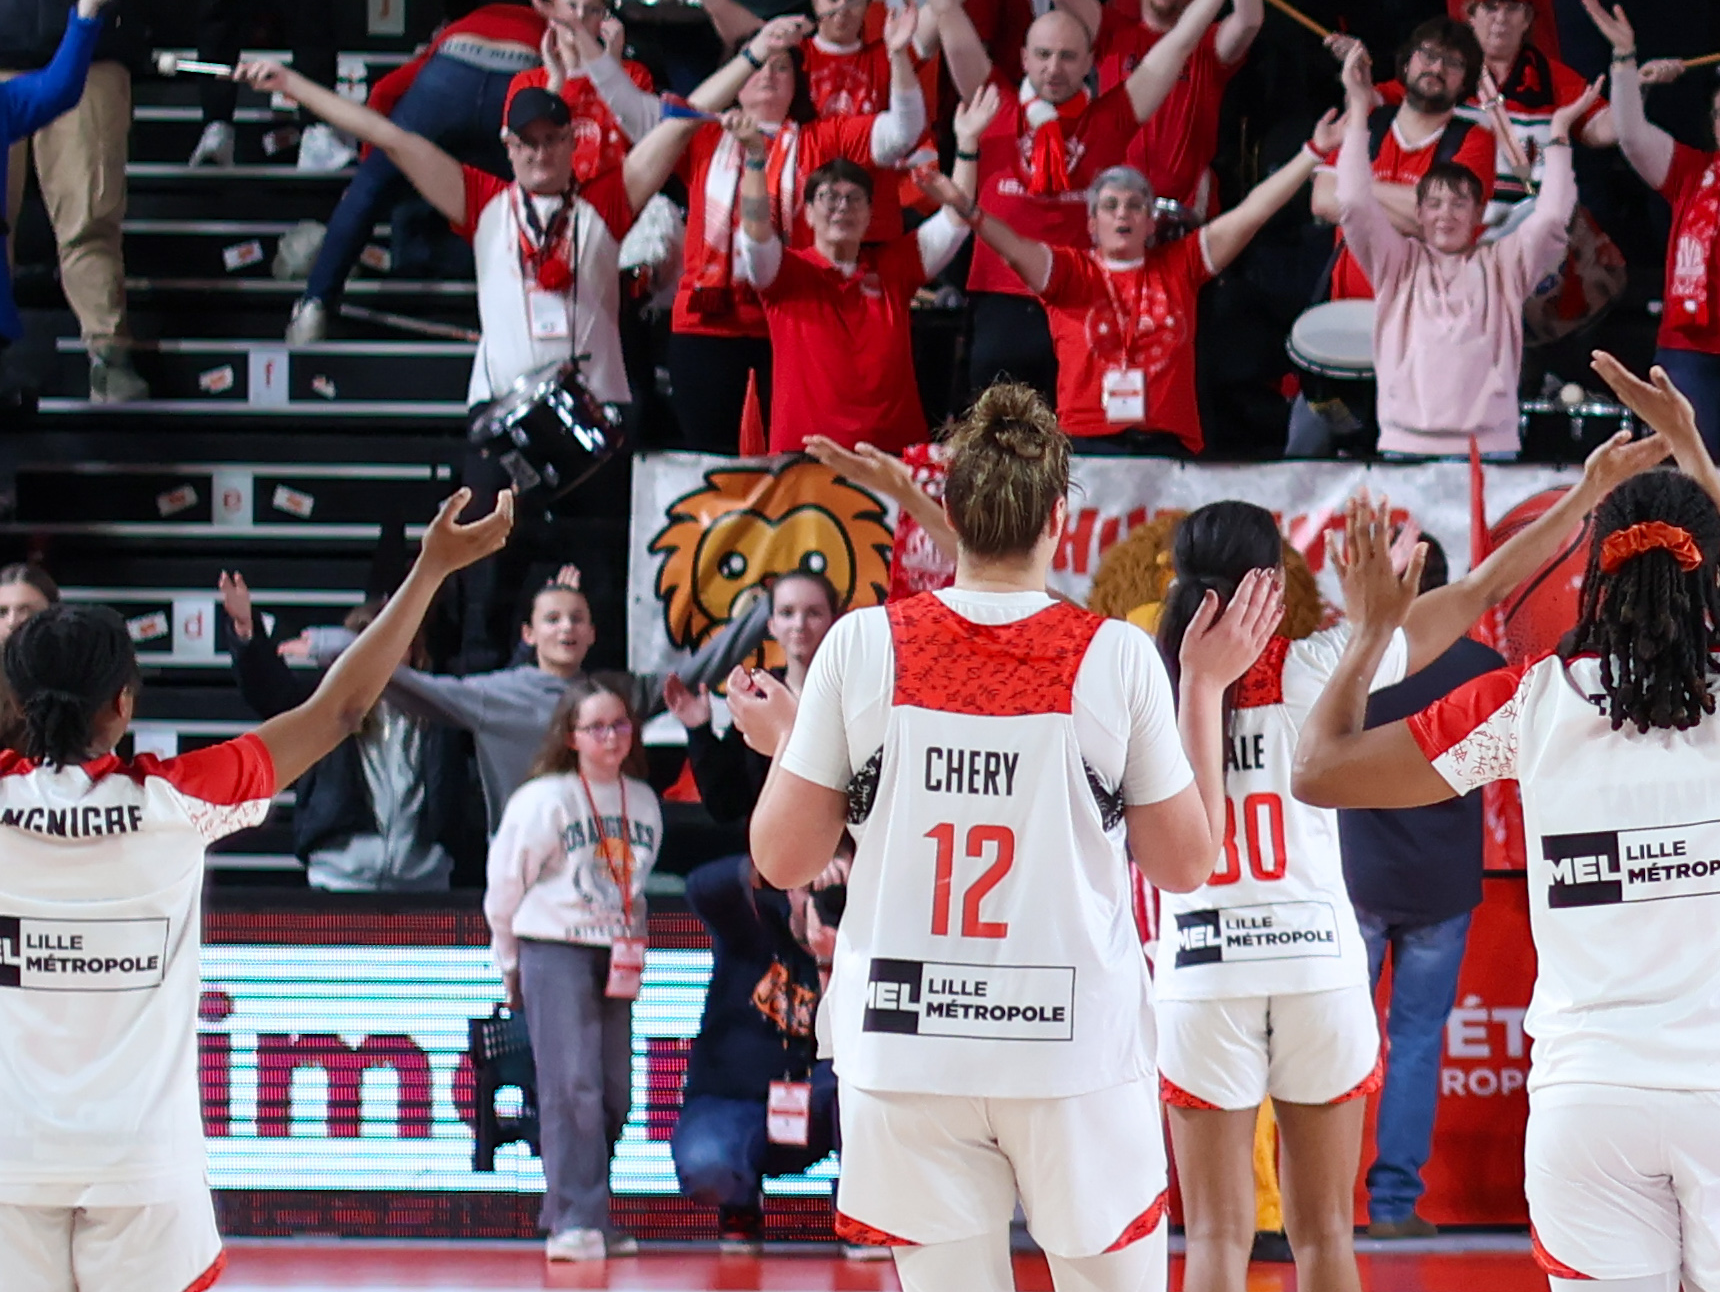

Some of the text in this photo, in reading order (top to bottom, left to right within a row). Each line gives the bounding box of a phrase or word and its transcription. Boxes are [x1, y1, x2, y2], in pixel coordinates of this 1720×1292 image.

[924, 746, 1020, 797] CHERY
[1626, 839, 1687, 861] LILLE
[922, 822, 1016, 939] 12
[1547, 854, 1622, 886] MEL
[1225, 916, 1273, 931] LILLE
[26, 933, 83, 951] LILLE
[1226, 929, 1334, 948] MÉTROPOLE
[25, 953, 159, 974] MÉTROPOLE
[927, 978, 988, 997] LILLE
[925, 999, 1066, 1023] MÉTROPOLE
